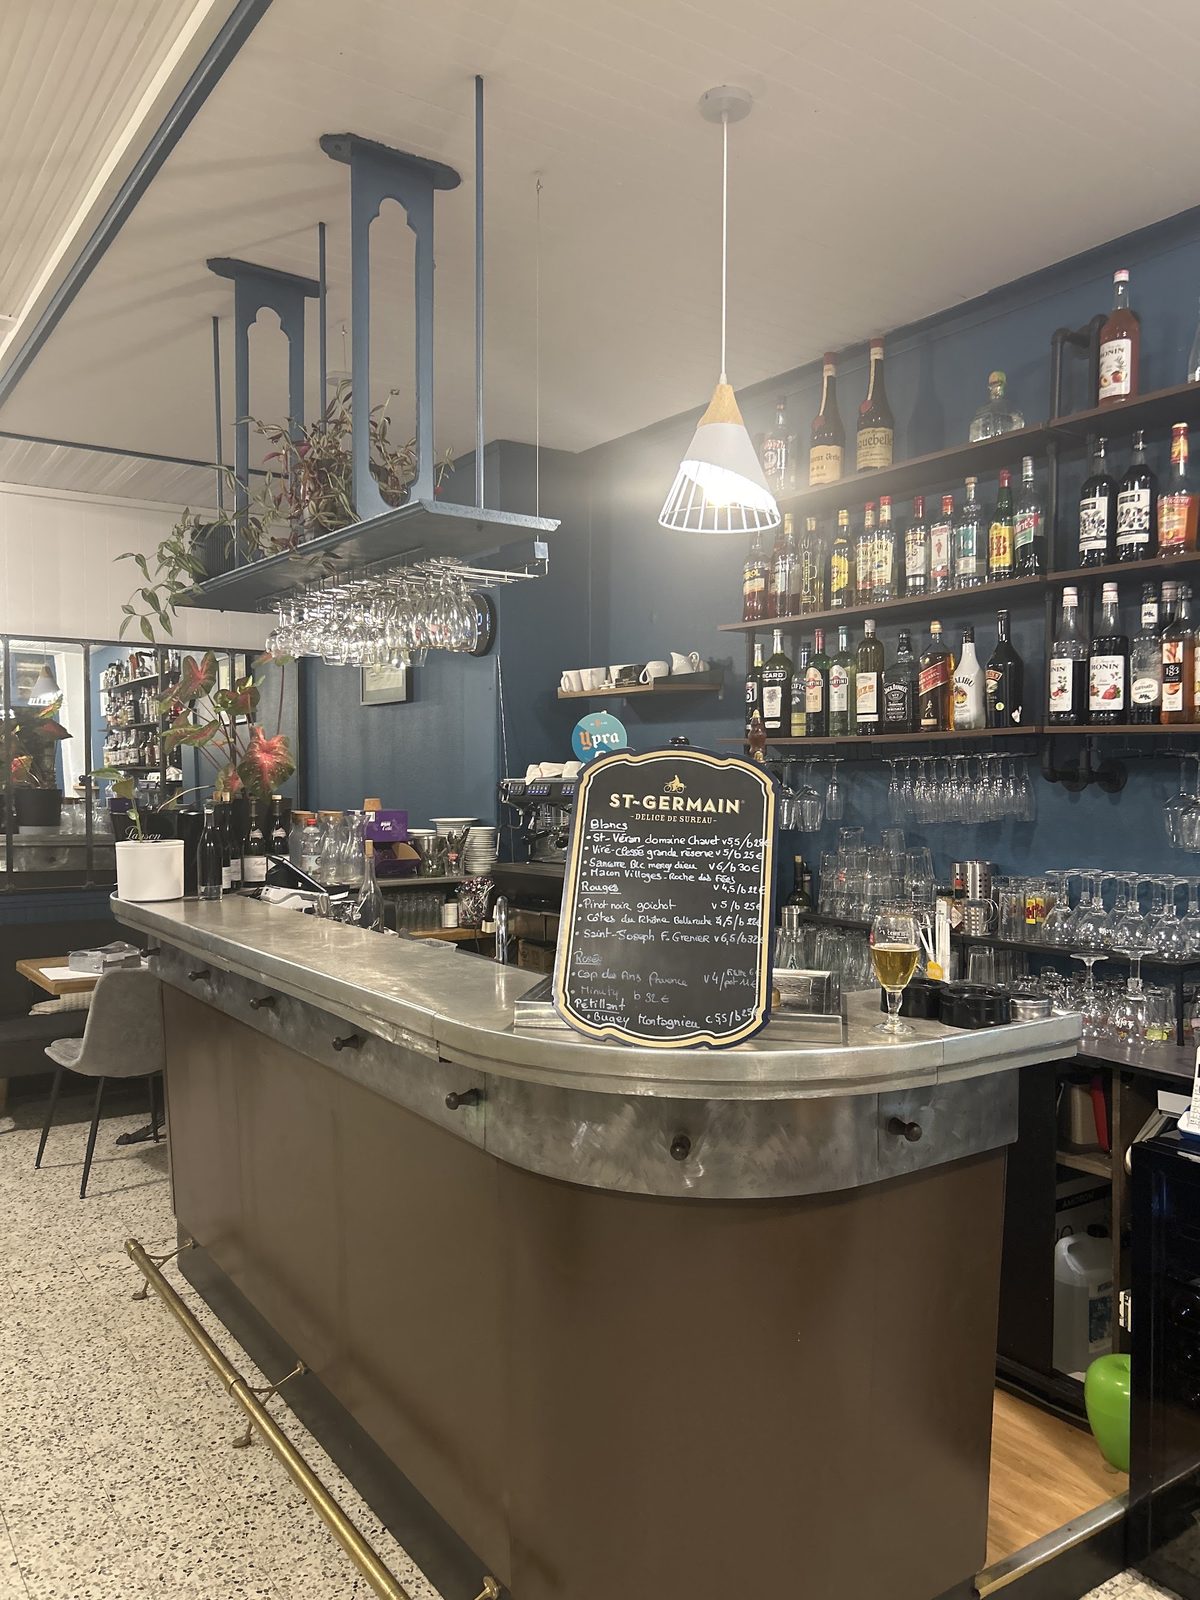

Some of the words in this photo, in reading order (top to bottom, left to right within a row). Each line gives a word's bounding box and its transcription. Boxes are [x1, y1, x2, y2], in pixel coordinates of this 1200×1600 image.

[590, 818, 628, 830] Blancs
[644, 834, 686, 844] domaine
[647, 848, 678, 860] grande
[581, 880, 619, 894] Rouges
[582, 897, 609, 909] Pinot
[586, 911, 616, 923] Côtes
[620, 914, 636, 923] du
